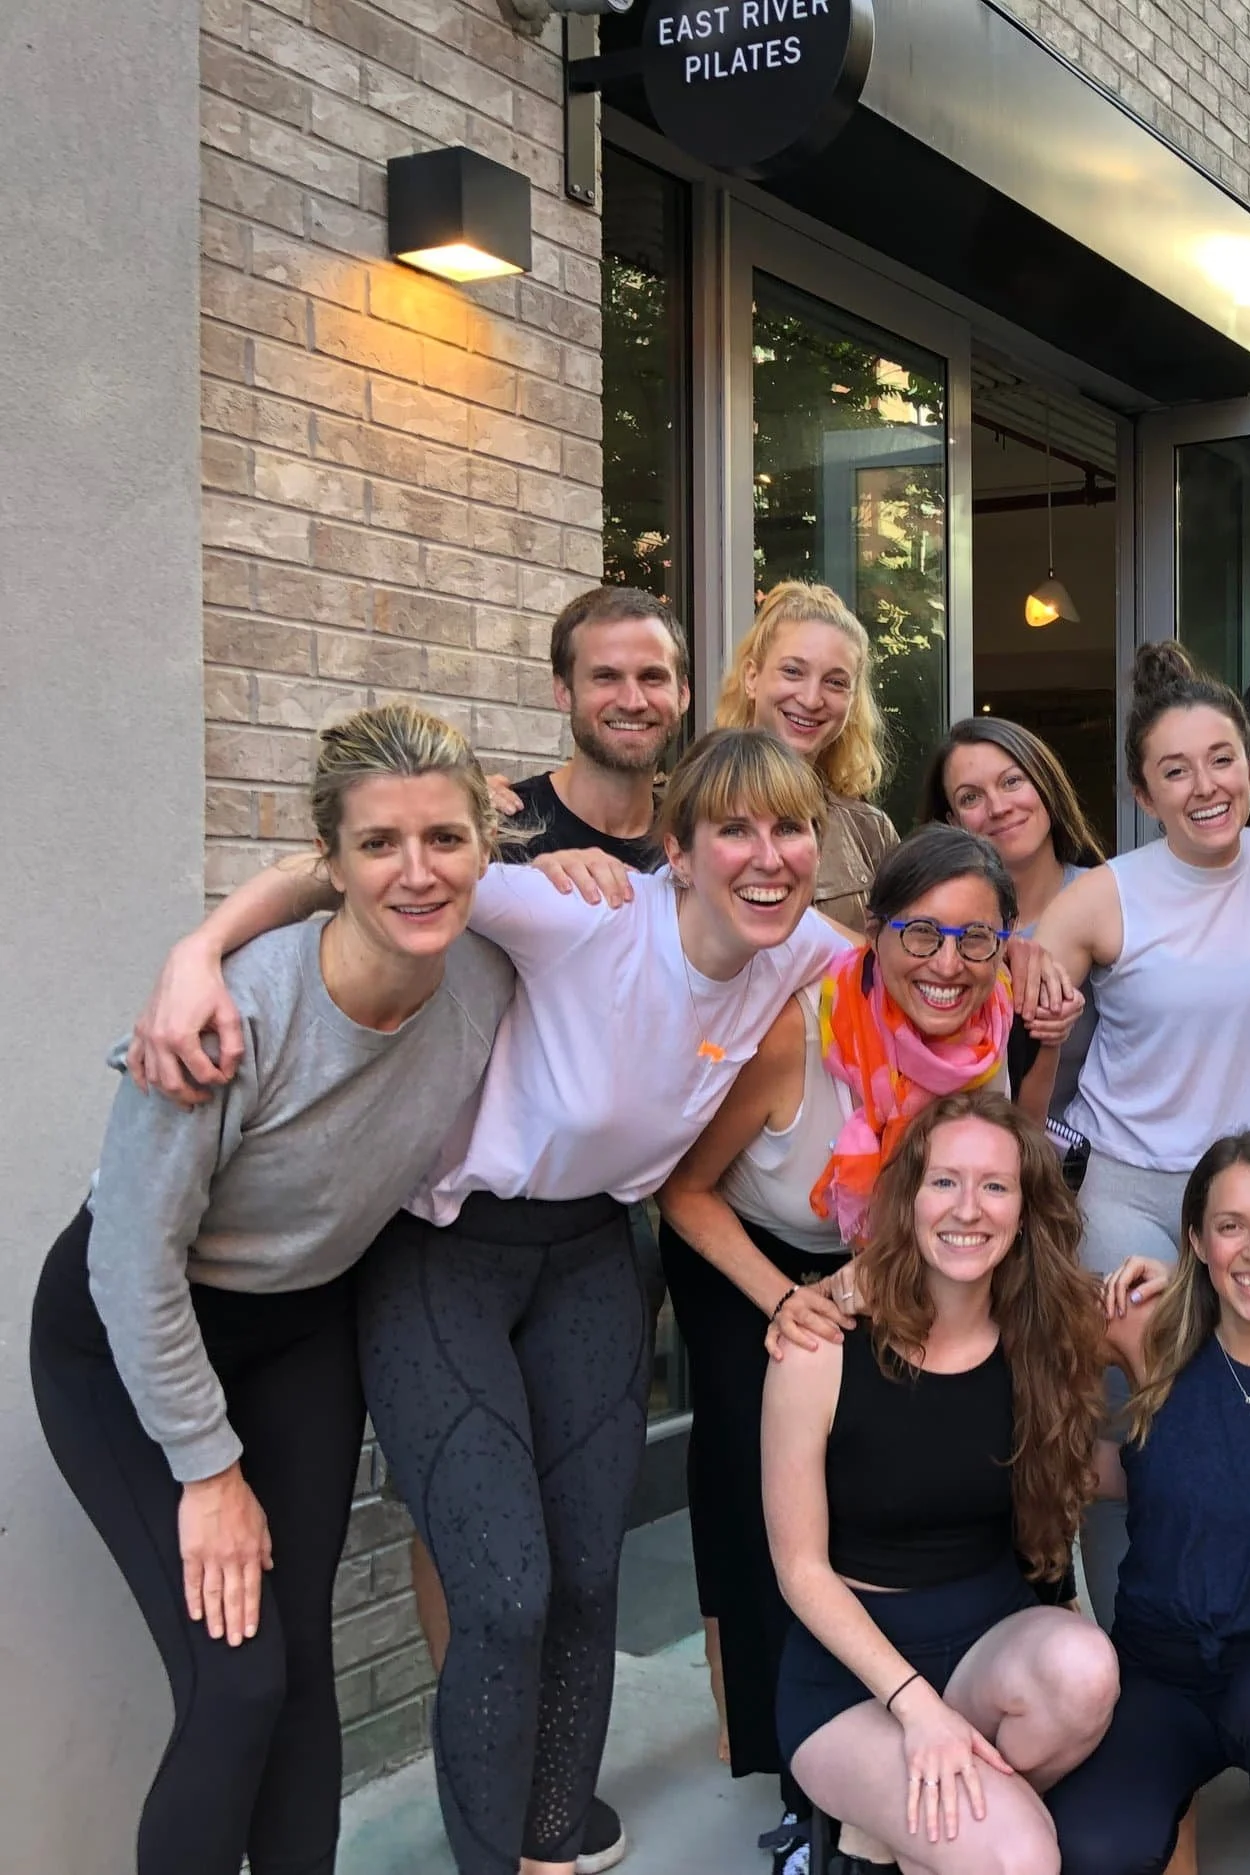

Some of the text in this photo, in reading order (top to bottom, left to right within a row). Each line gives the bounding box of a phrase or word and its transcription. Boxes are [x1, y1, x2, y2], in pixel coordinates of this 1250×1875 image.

[659, 0, 829, 45] EAST RIVER
[685, 36, 801, 83] PILATES
